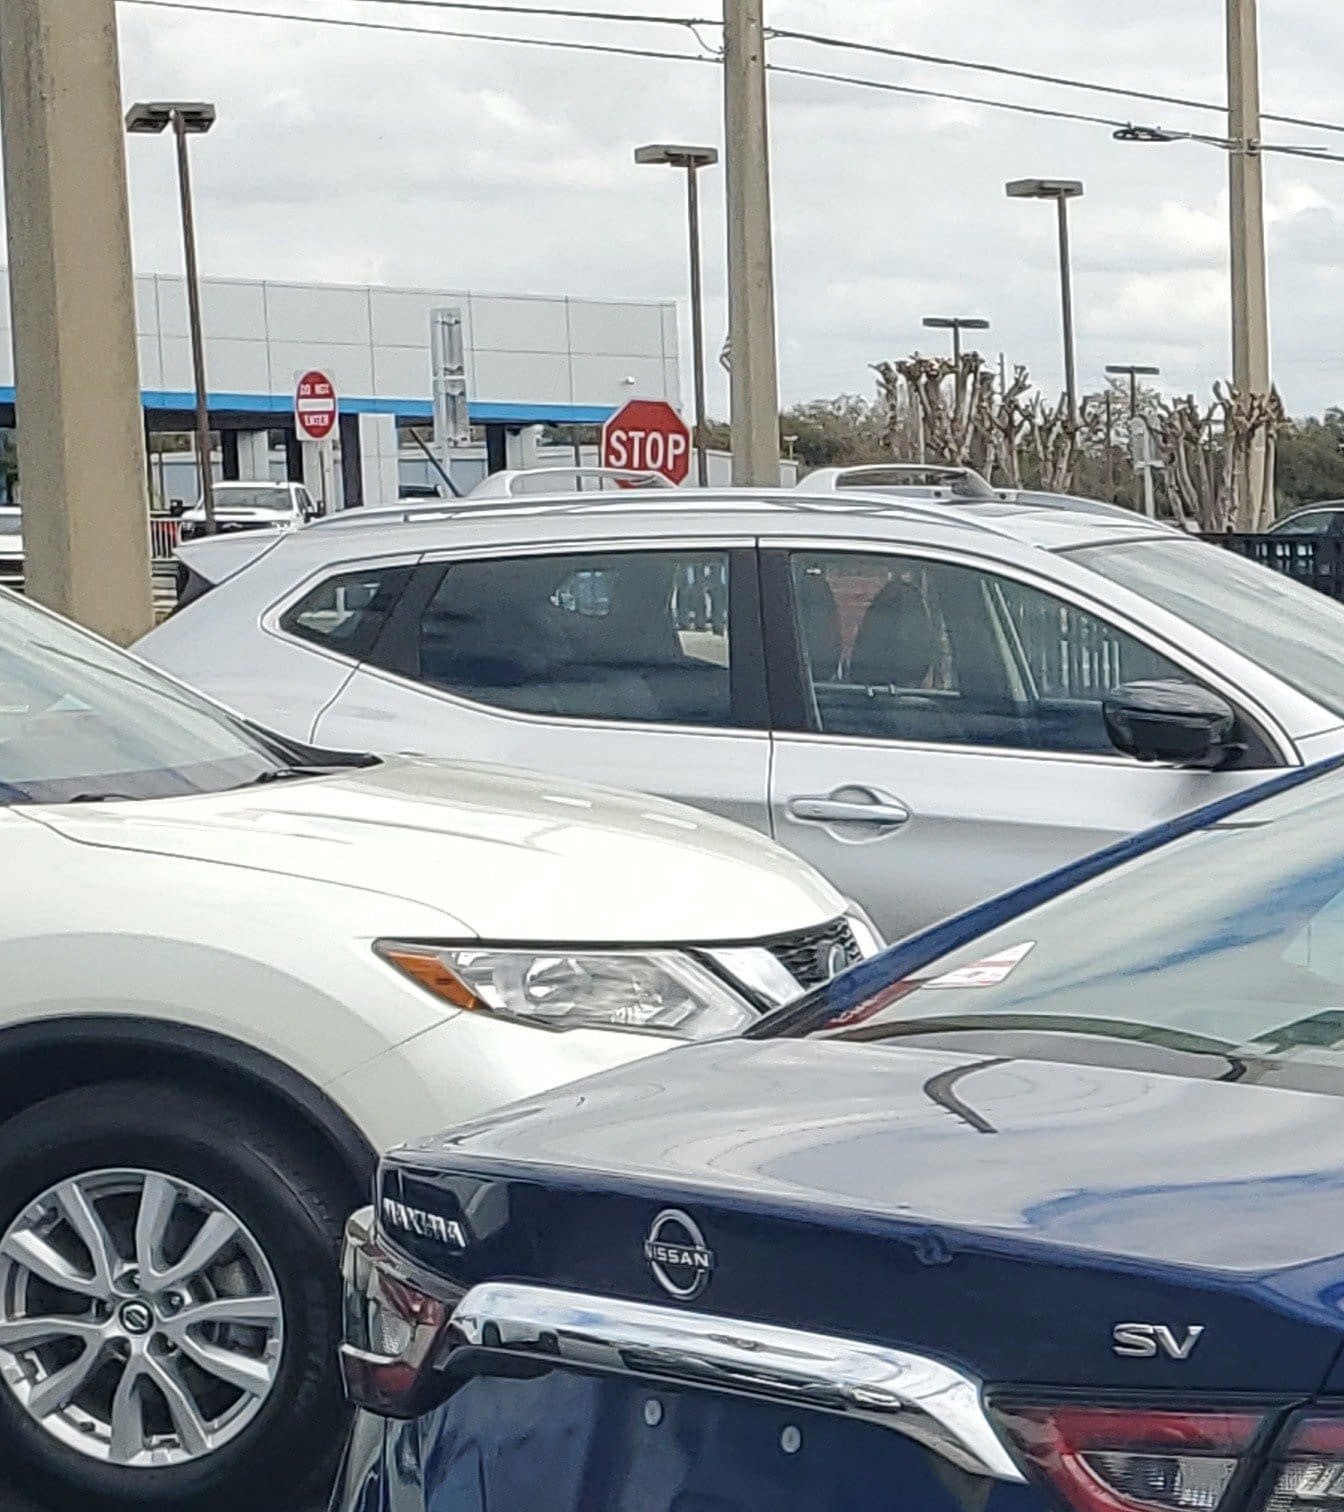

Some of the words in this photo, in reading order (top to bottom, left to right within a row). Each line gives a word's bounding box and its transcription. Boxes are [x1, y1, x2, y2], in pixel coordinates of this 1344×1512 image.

[608, 429, 686, 471] STOP
[646, 1242, 709, 1268] NISSAN
[1113, 1323, 1205, 1359] SV
